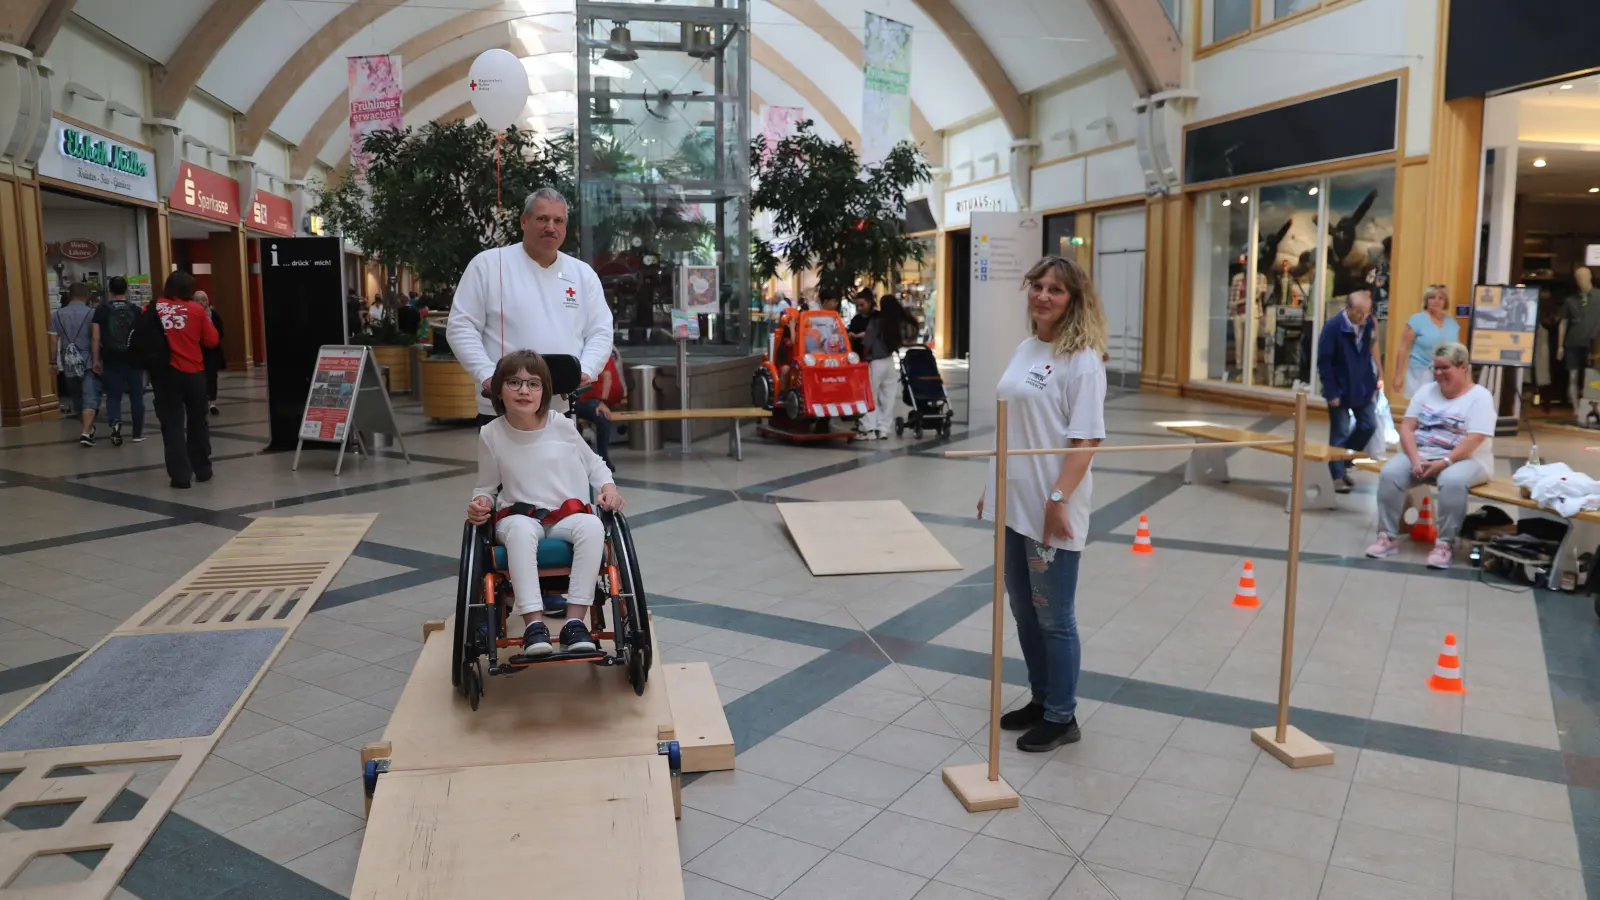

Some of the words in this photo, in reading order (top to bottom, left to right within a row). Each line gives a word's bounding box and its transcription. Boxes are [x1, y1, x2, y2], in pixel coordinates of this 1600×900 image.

[351, 99, 399, 112] Frühlings-
[352, 109, 397, 122] erwachen
[62, 127, 108, 166] Elsbeth
[108, 144, 147, 177] Müller
[197, 190, 229, 215] Sparkasse
